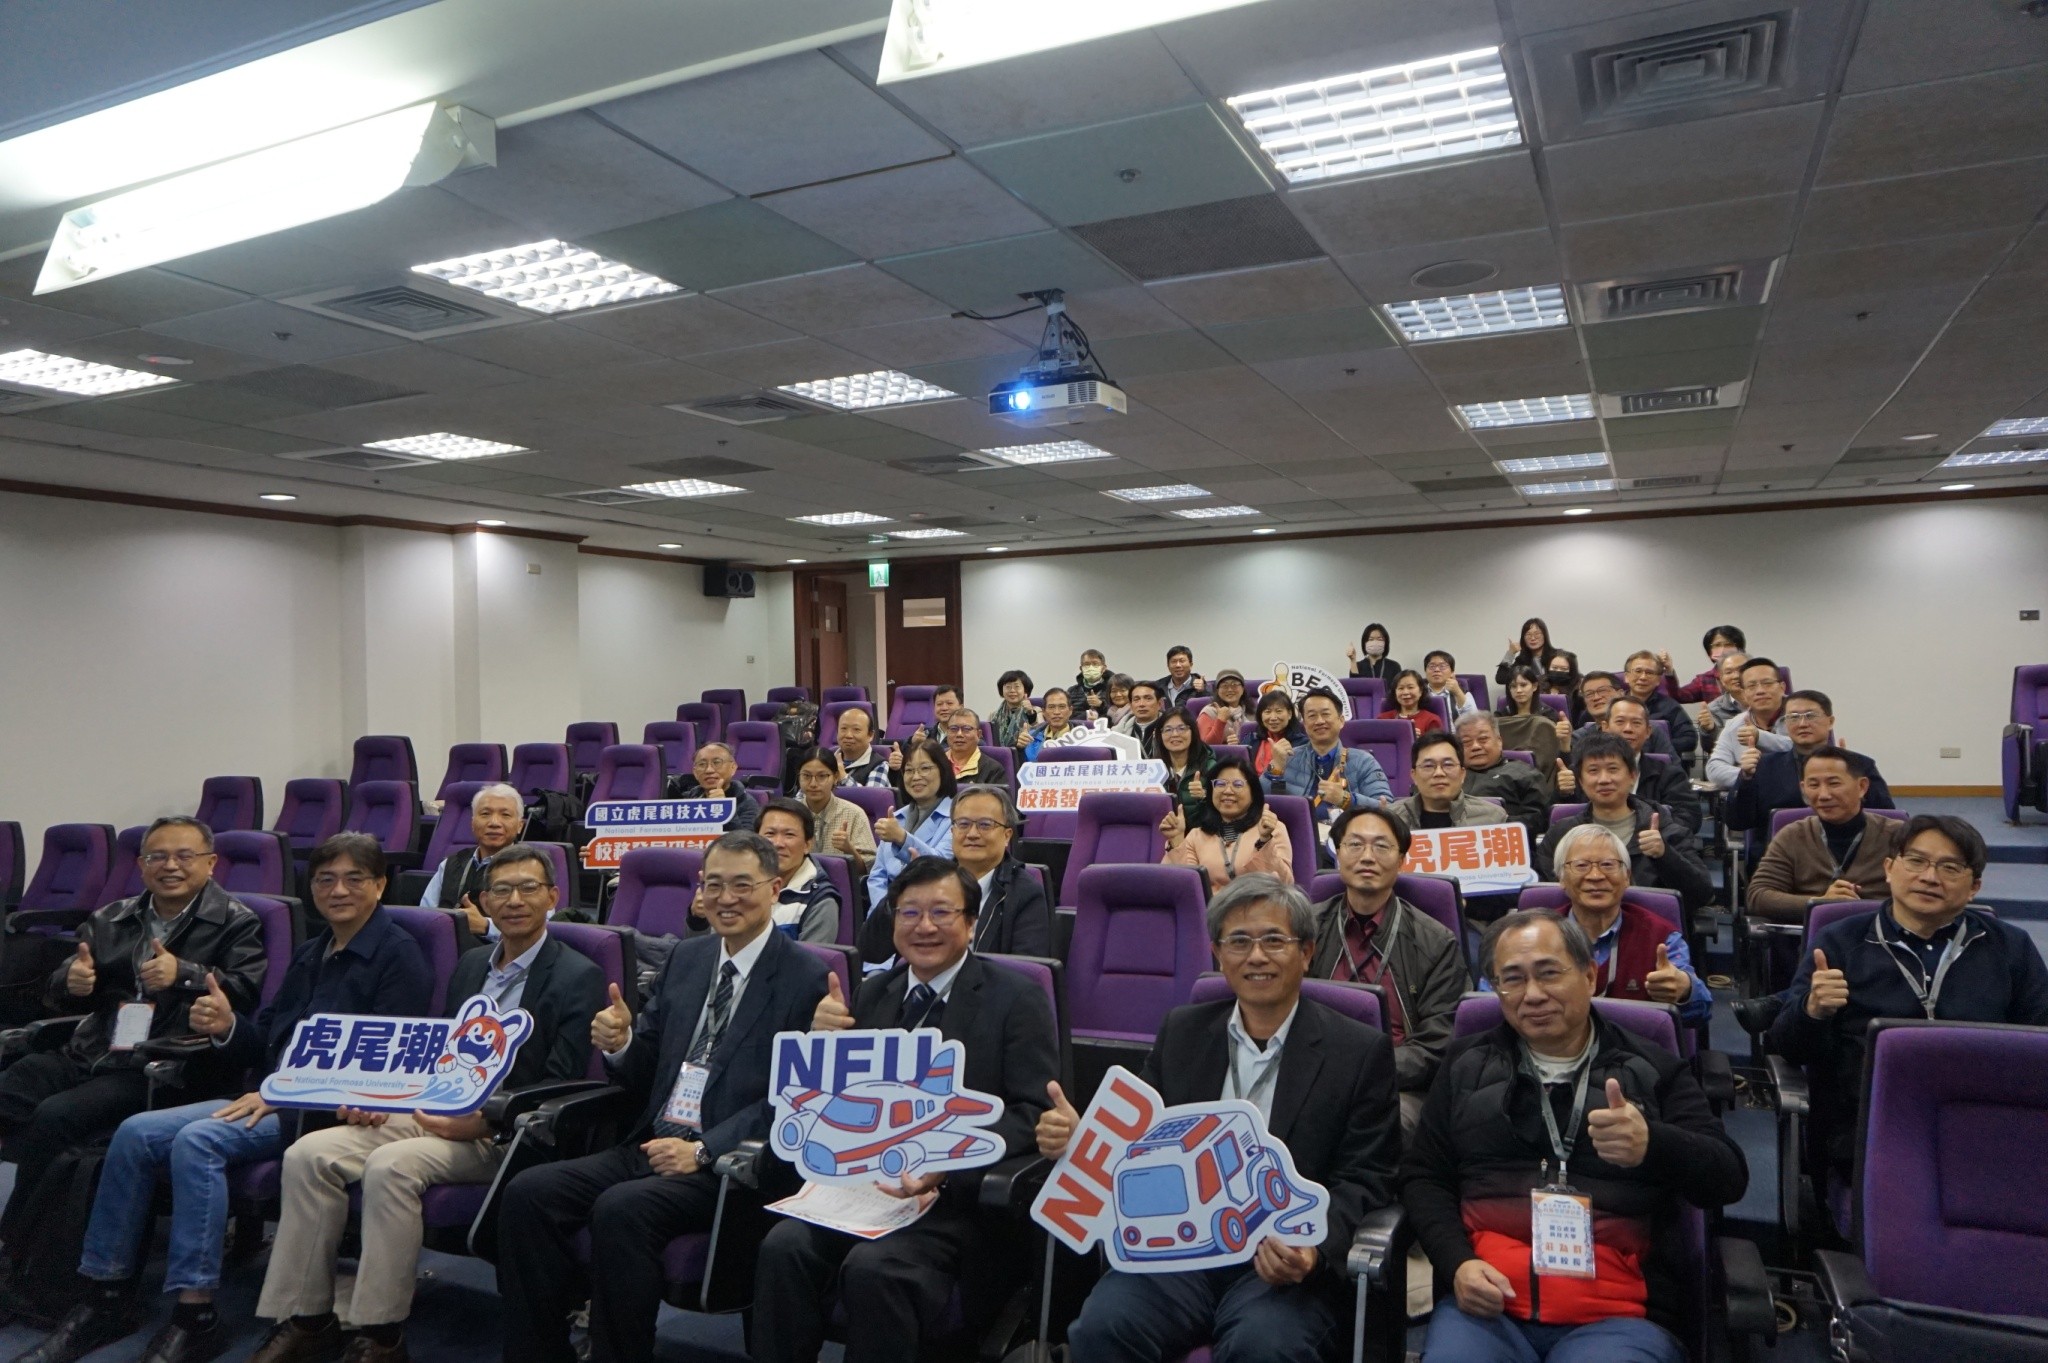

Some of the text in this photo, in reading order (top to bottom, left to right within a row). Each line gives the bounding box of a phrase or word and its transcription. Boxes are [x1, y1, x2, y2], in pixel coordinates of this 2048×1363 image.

[1291, 672, 1322, 690] BE
[1035, 763, 1148, 778] 國立虎尾科技大學
[594, 803, 724, 822] 國立虎尾科技大學
[675, 825, 715, 833] University
[1400, 826, 1526, 873] 虎尾潮
[286, 1017, 450, 1075] 虎尾潮
[776, 1035, 932, 1096] NFU
[294, 1075, 406, 1090] National Formosa University
[1039, 1076, 1154, 1244] NFU
